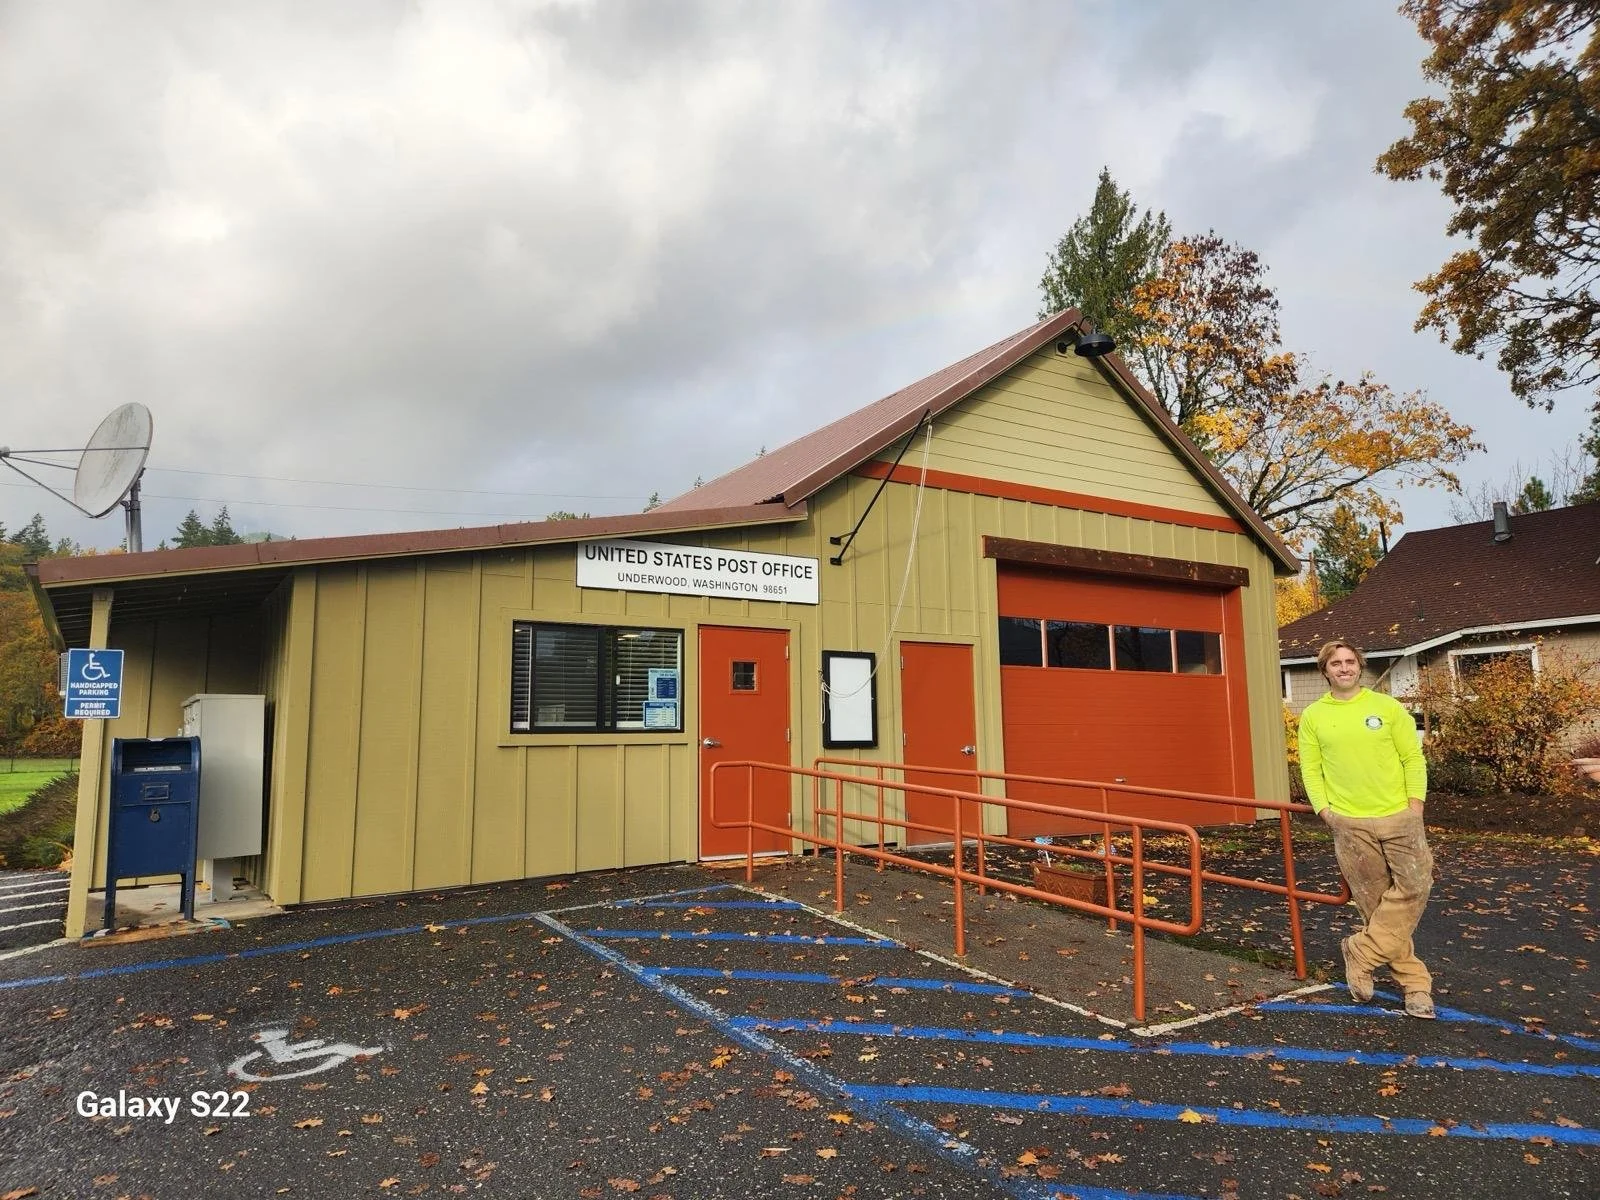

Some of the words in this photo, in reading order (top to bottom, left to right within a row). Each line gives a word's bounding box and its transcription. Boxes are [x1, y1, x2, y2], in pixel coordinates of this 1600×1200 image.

[585, 545, 648, 564] UNITED
[653, 551, 712, 570] STATES
[718, 557, 757, 575] POST
[762, 561, 813, 579] OFFICE
[617, 572, 690, 588] UNDERWOOD,
[692, 578, 758, 592] WASHINGTON
[762, 584, 788, 595] 98651
